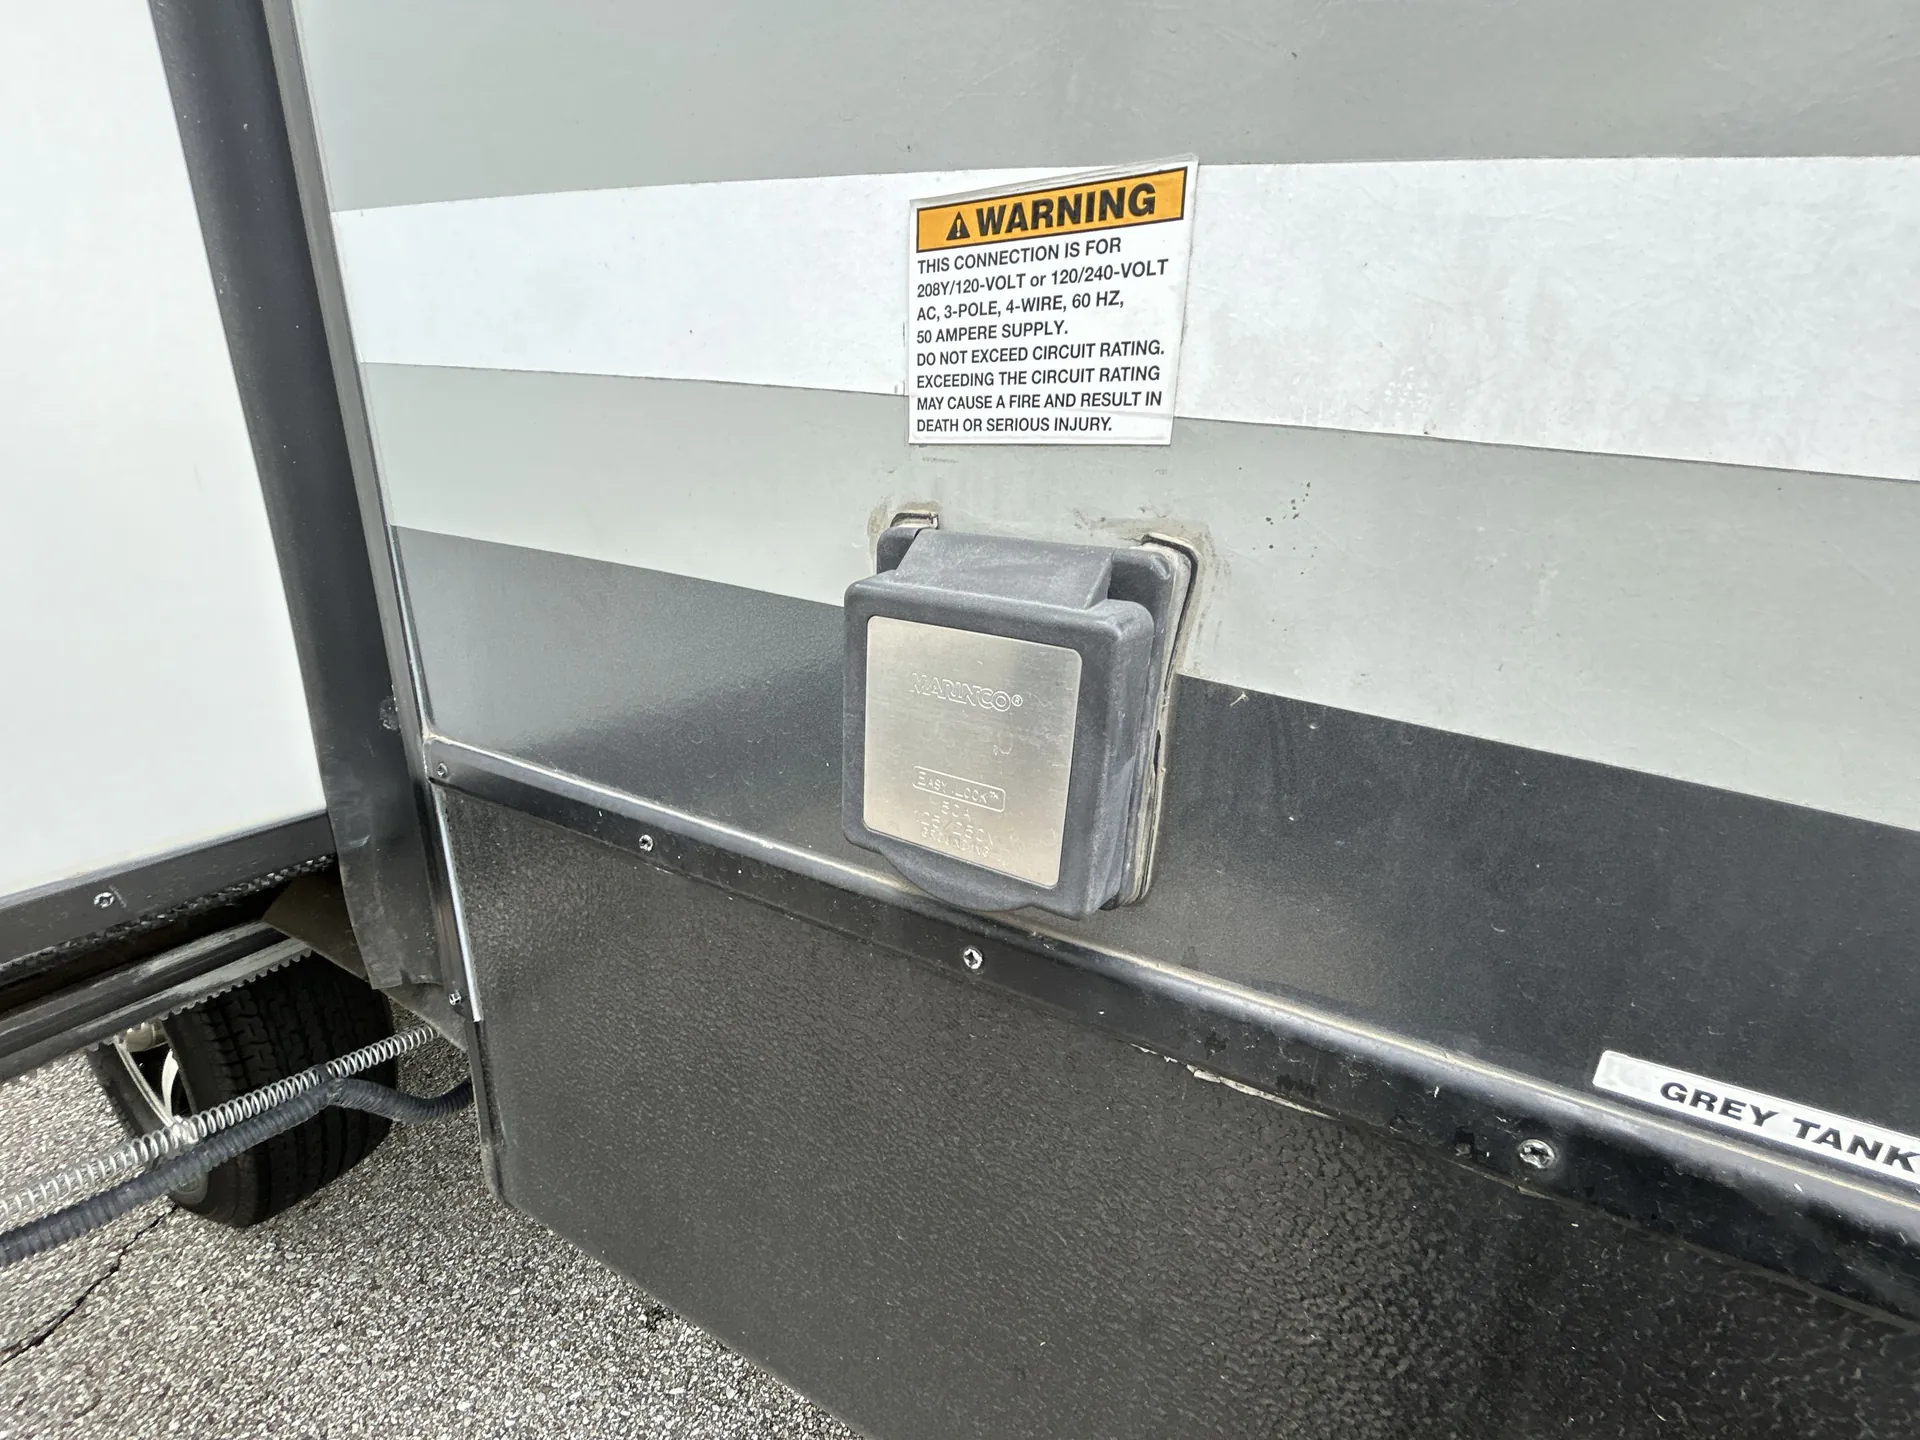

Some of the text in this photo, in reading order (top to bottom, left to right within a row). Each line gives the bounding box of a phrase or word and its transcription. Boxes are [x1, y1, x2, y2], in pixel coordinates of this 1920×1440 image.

[976, 182, 1156, 237] WARNING
[917, 237, 1122, 275] THIS CONNECTION IS FOR
[917, 258, 1169, 298] 208Y/120-VOLT or 120/240-VOLT
[917, 290, 1124, 322] AC, 3-POLE, 4-WIRE, 60 HZ,
[917, 320, 1068, 344] 50 AMPERE SUPPLY.
[917, 339, 1165, 366] DO NOT EXCEED CIRCUIT RATING.
[917, 365, 1160, 389] EXCEEDING THE CIRCUIT RATING
[917, 390, 1162, 410] MAY CAUSE A FIRE AND RESULT IN
[917, 416, 1112, 432] DEATH OR SERIOUS INJURY.
[1660, 1081, 1920, 1173] GREY TANK
